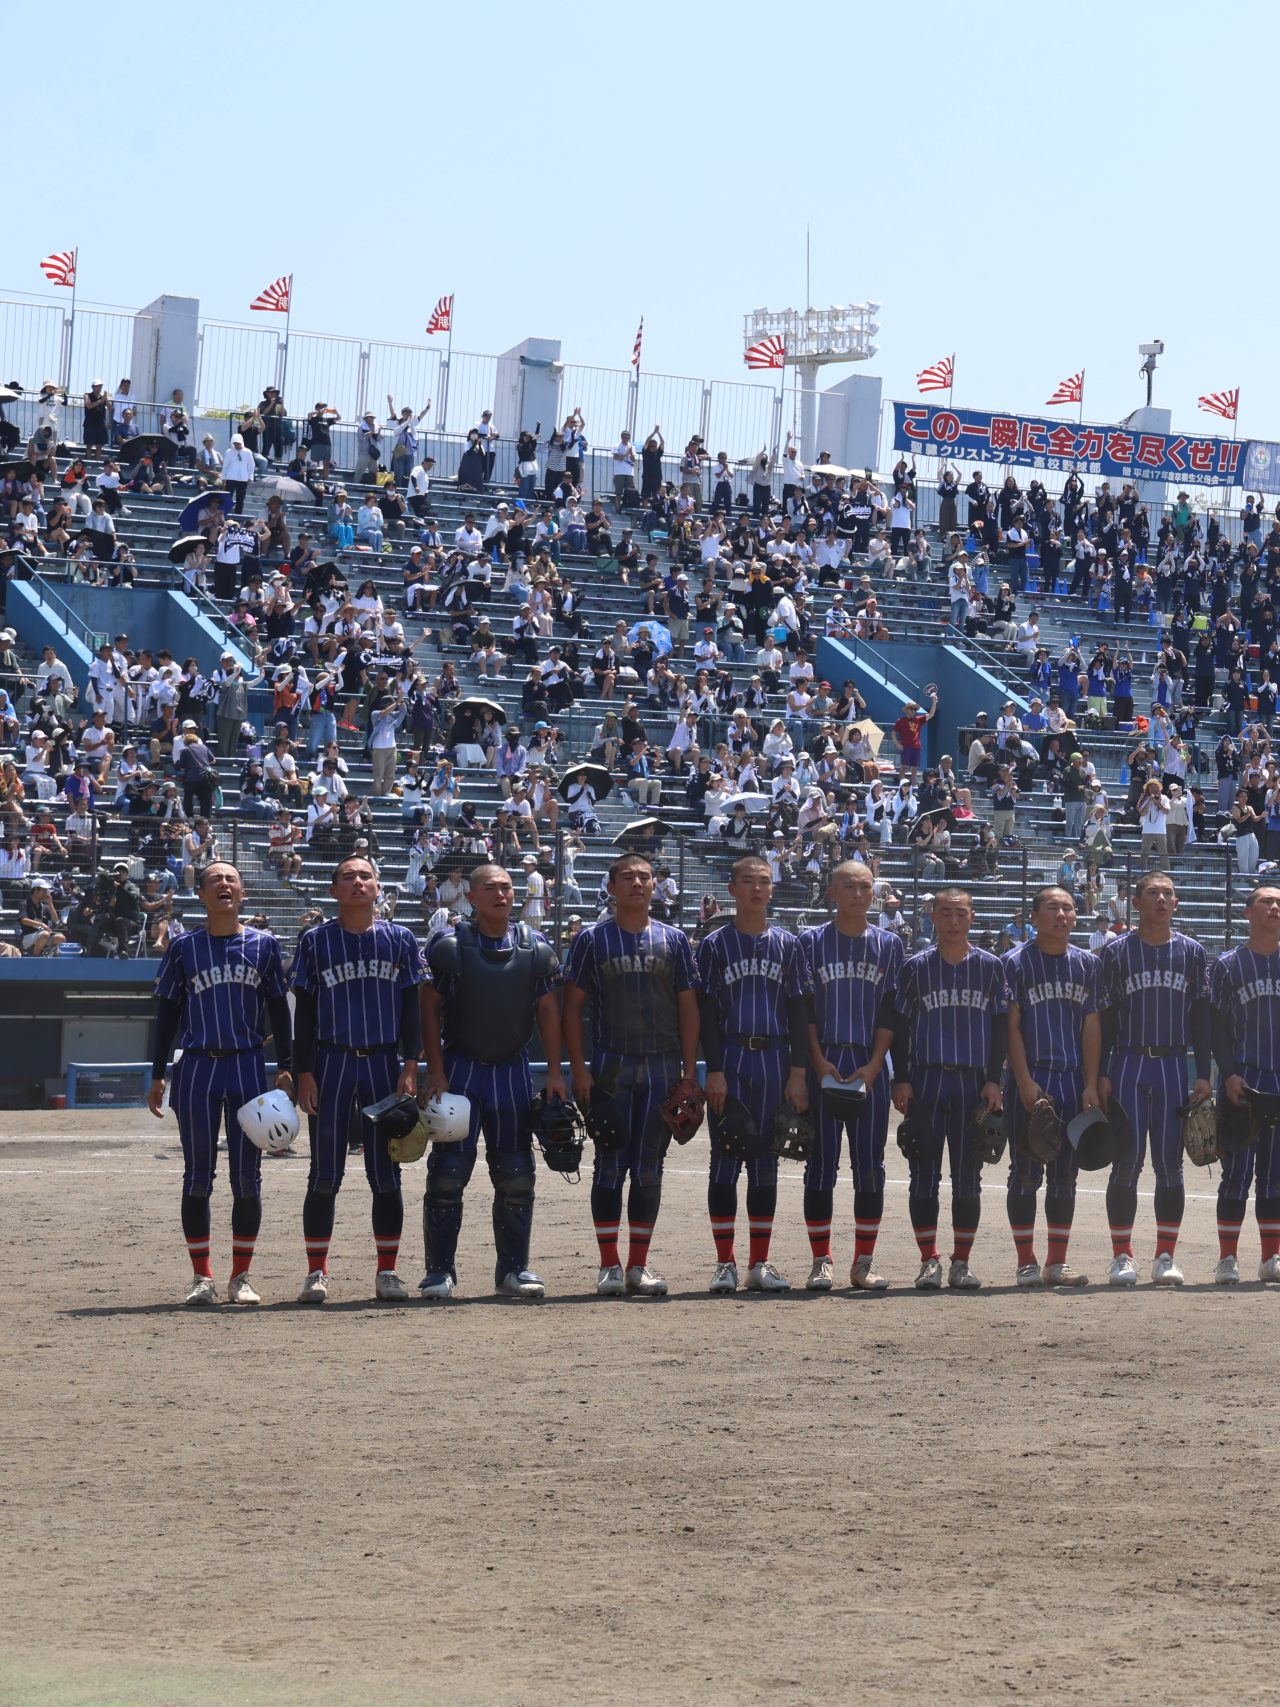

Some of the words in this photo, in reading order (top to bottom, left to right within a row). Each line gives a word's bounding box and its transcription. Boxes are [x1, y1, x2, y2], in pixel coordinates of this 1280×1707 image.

[903, 408, 1241, 472] この一瞬に全力を尽くせ!!
[321, 960, 400, 988] HIGASHI
[724, 958, 783, 984] HIGASHI
[817, 961, 884, 985] HIGASHI
[1124, 969, 1188, 995] HIGASHI
[922, 988, 988, 1011] HIGASHI
[1027, 981, 1089, 1005] HIGASHI
